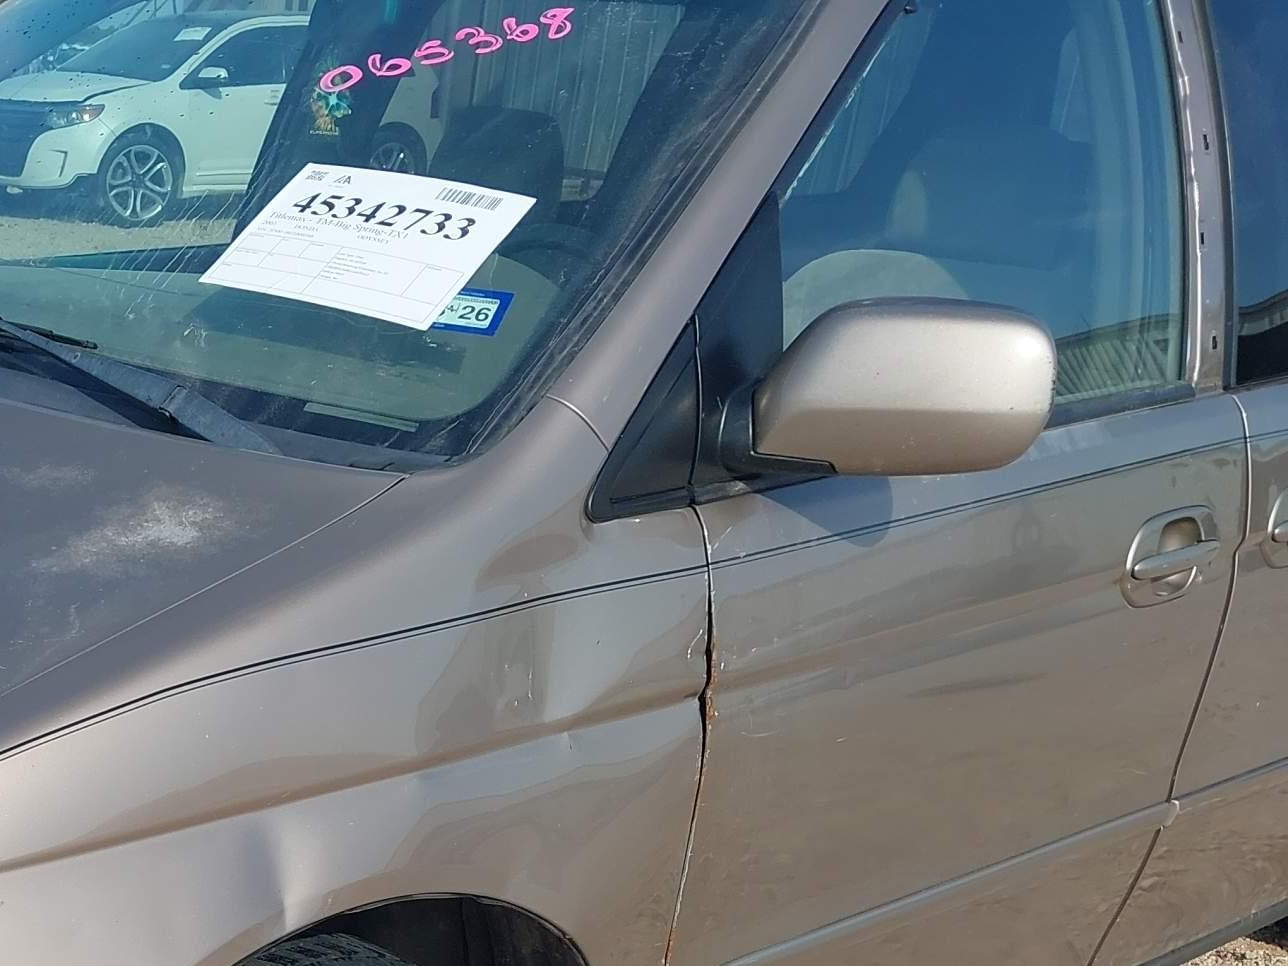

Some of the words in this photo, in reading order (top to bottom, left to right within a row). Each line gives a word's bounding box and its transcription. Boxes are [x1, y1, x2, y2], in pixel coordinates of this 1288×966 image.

[319, 7, 575, 92] 065368
[292, 192, 476, 241] 45342733
[457, 305, 492, 322] 26
